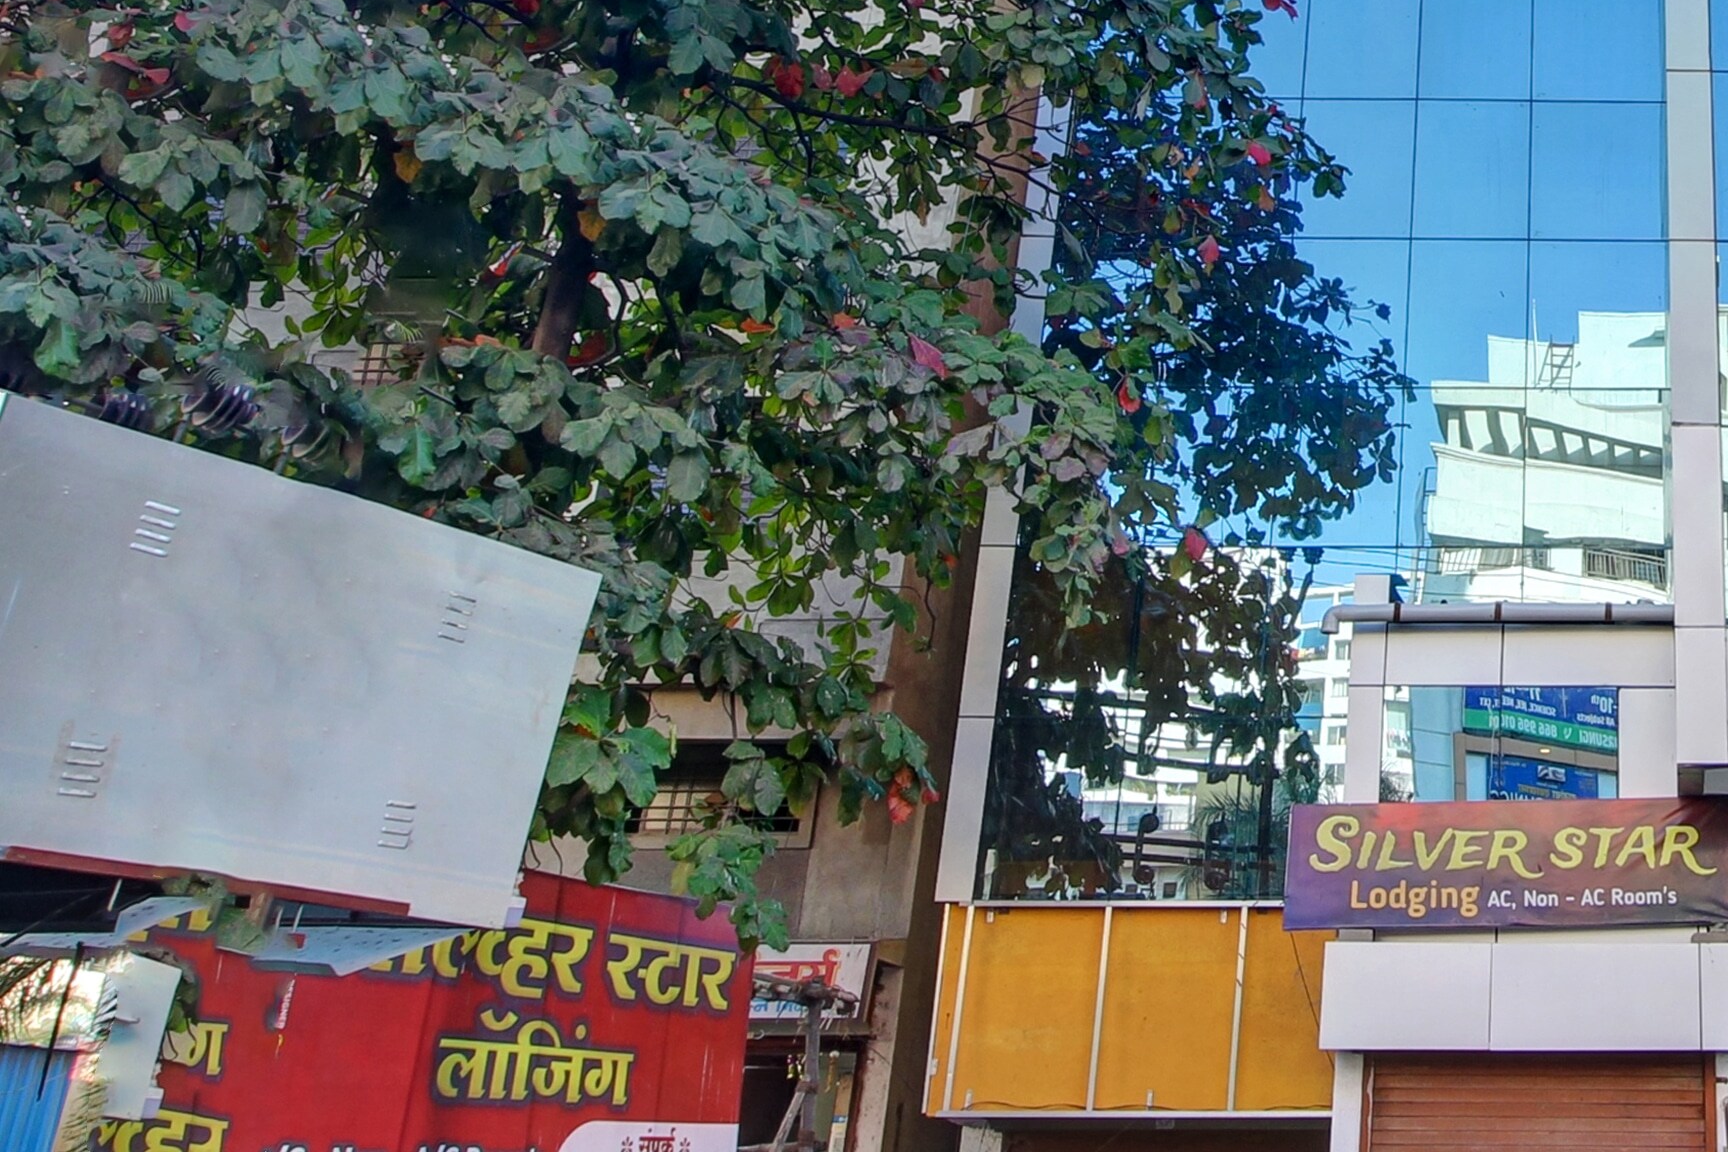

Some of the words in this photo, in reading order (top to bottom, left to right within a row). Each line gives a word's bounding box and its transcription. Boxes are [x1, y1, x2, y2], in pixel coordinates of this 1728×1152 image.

[1309, 814, 1545, 880] SILVER
[1549, 824, 1717, 876] STAR
[1350, 879, 1480, 918] Lodging
[1487, 890, 1516, 909] AC,
[1523, 890, 1559, 908] Non
[1581, 889, 1605, 907] AC
[1611, 885, 1678, 906] Room's
[606, 933, 736, 1011] स्टार
[437, 1008, 635, 1106] लॉजिंग
